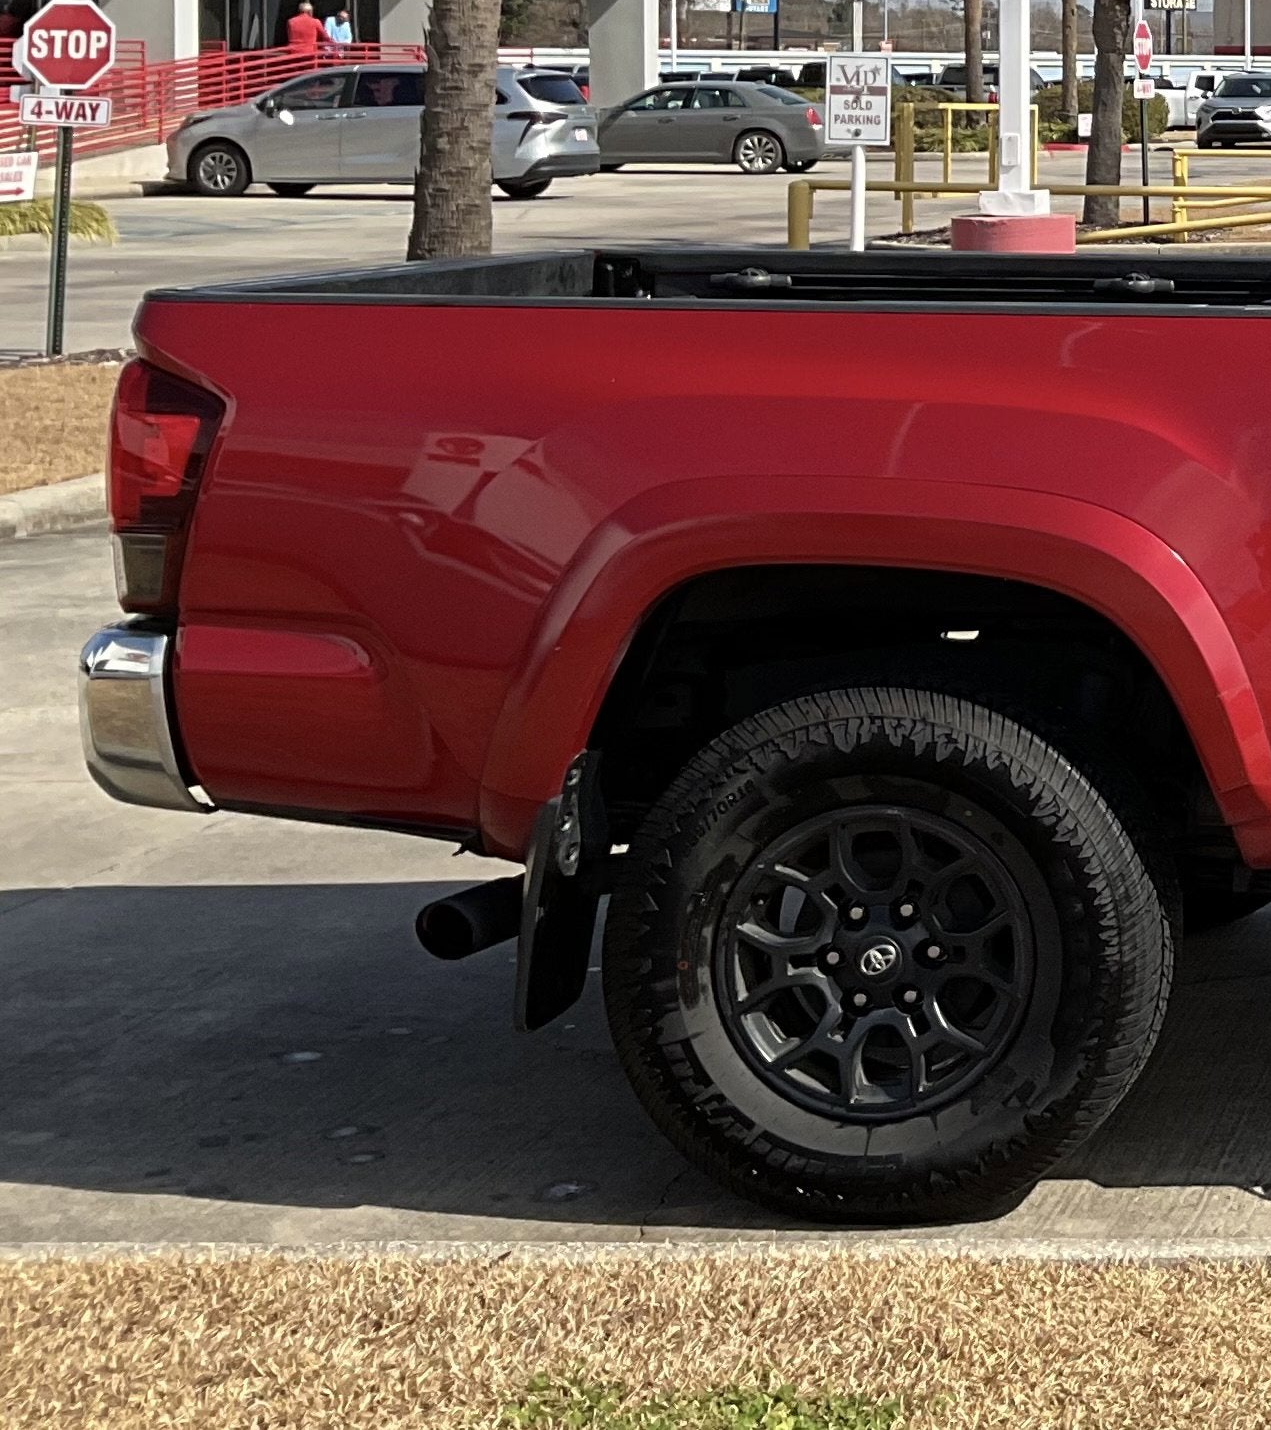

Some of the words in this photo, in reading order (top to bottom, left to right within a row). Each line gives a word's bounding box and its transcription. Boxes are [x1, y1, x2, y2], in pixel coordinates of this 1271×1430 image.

[30, 28, 109, 59] STOP
[30, 100, 102, 121] 4-WAY
[843, 99, 873, 111] SOLD
[833, 114, 882, 126] PARKING
